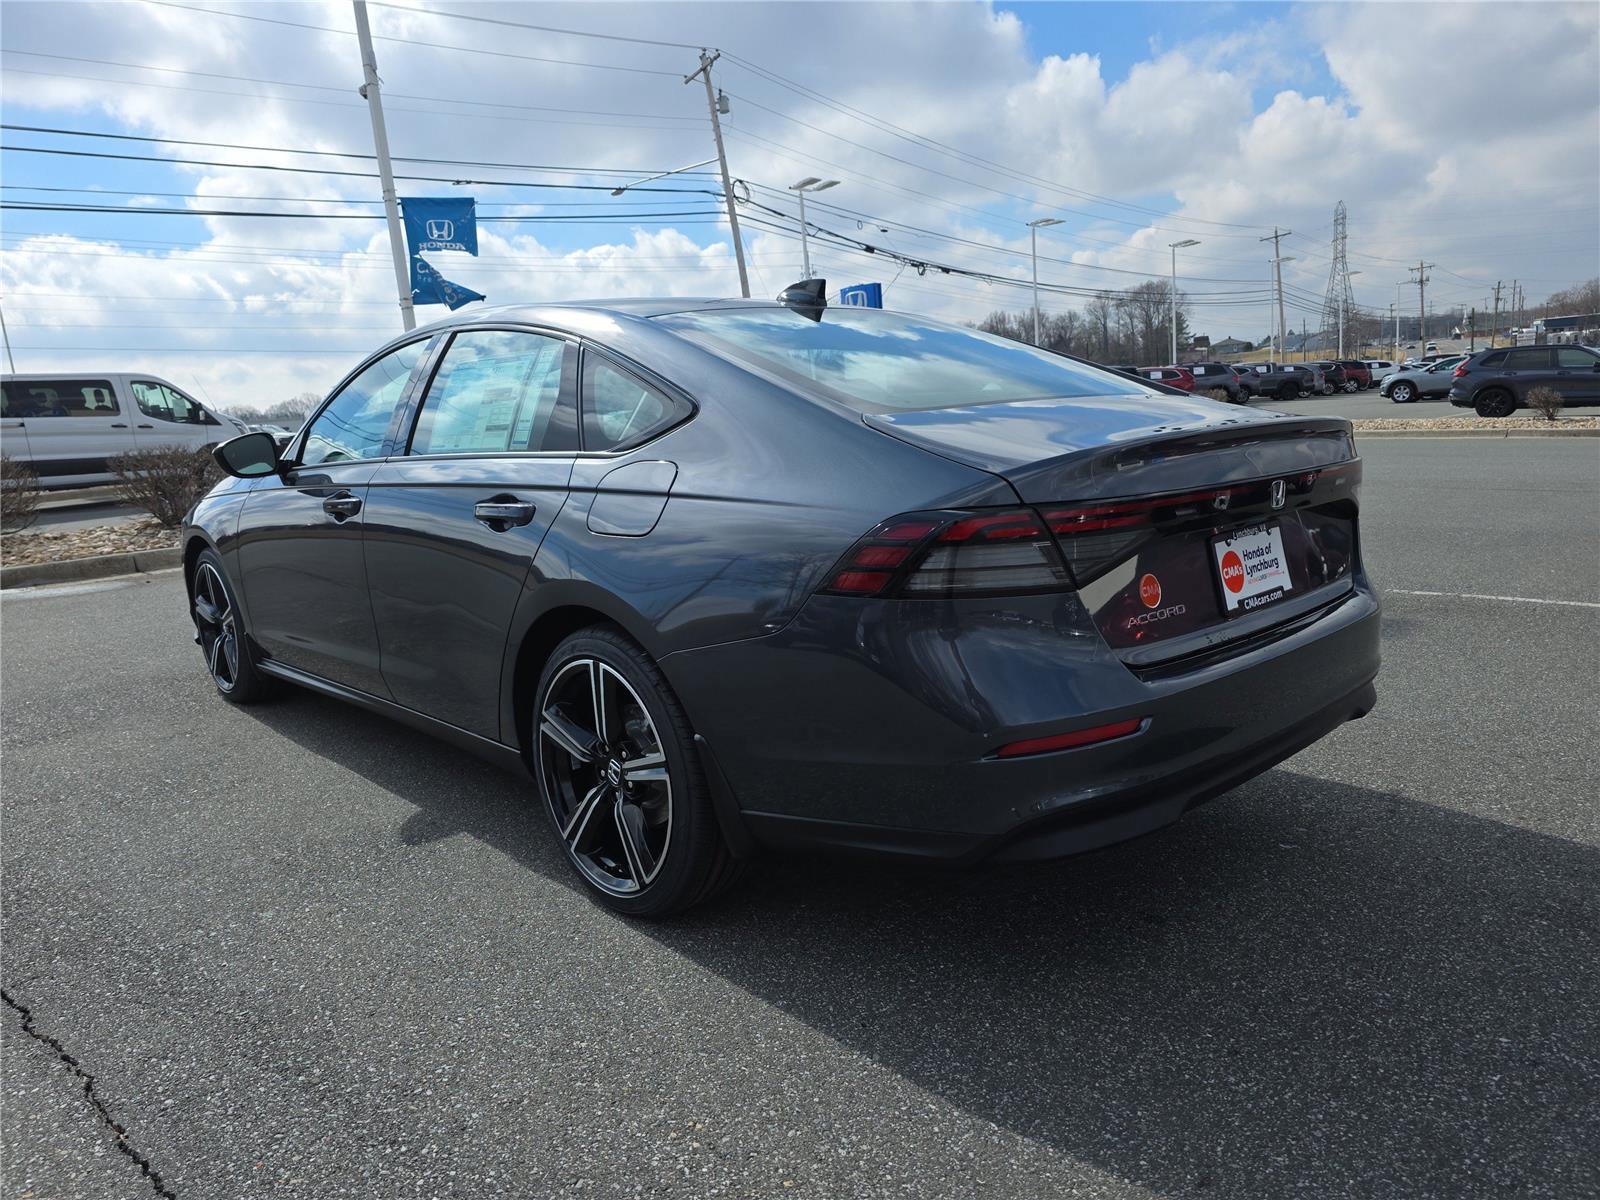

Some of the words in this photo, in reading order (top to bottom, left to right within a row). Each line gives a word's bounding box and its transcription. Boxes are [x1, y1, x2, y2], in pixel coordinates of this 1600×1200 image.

[419, 242, 466, 251] HONDA
[1242, 545, 1264, 561] Honda
[1265, 542, 1272, 555] of
[1223, 565, 1243, 579] CMA's
[1245, 557, 1279, 577] Lynchburg
[1244, 590, 1283, 610] CMAcars.com
[1127, 604, 1186, 628] ACCORD
